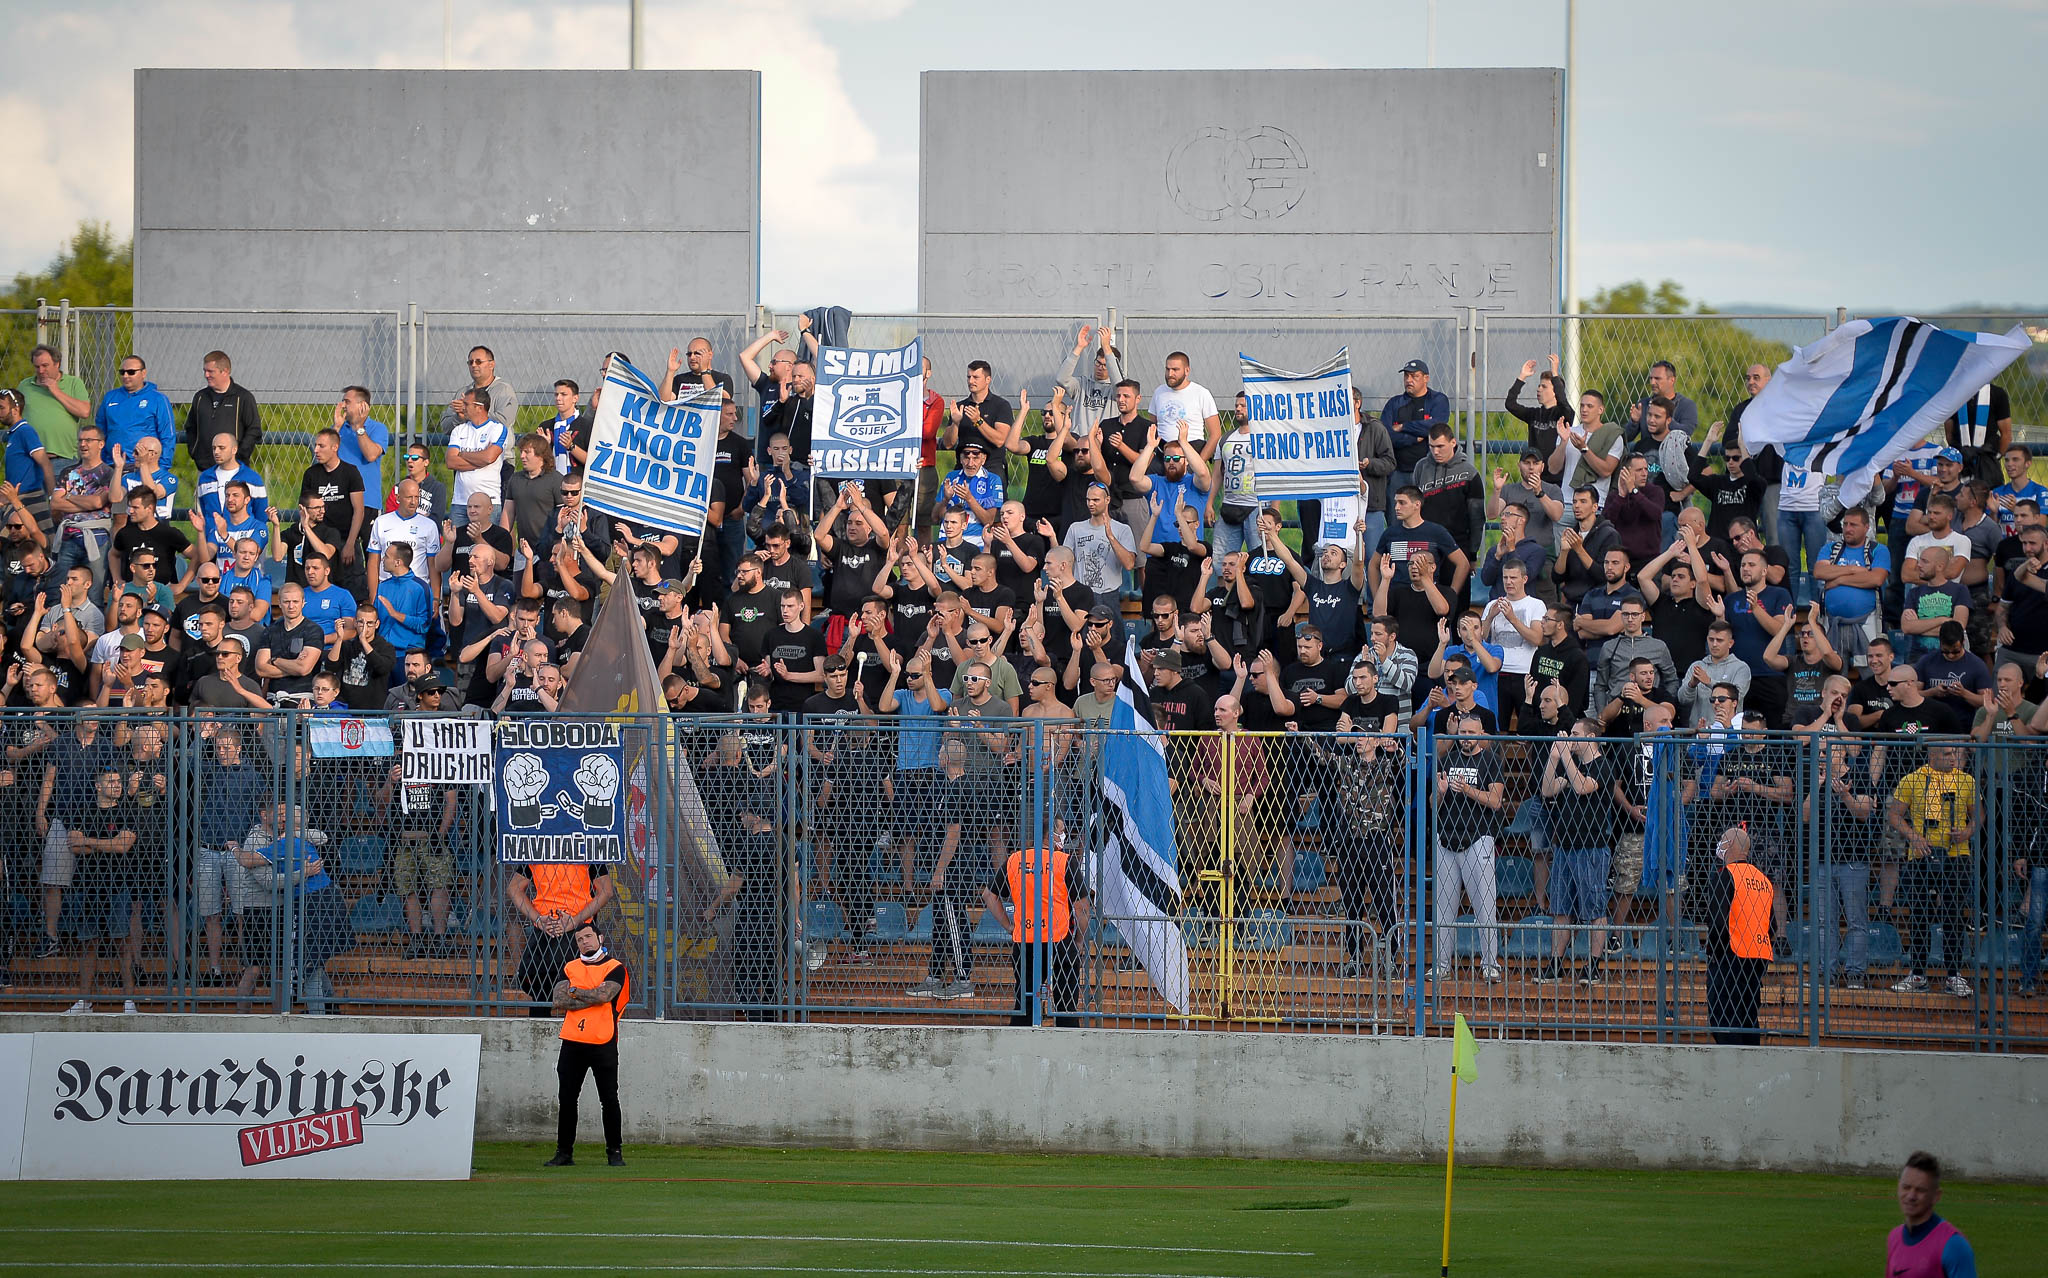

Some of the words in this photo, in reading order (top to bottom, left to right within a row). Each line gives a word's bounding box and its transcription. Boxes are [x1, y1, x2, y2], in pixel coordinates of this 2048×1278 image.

[824, 341, 918, 376] SAMO
[620, 392, 702, 438] KLUB
[1296, 392, 1315, 419] TE
[1318, 384, 1350, 417] NAŠI
[618, 422, 697, 467] MOG
[849, 425, 888, 436] OSIJEK
[1304, 429, 1350, 459] PRATE
[590, 440, 708, 502] ŽIVOTA
[411, 721, 424, 748] U
[432, 722, 479, 749] INAT
[501, 722, 621, 749] SLOBODA
[403, 753, 491, 781] DRUGIMA
[502, 831, 621, 863] NAVIJAČIMA
[577, 1018, 587, 1033] 4
[53, 1055, 452, 1127] Varaždinske
[244, 1110, 358, 1161] VIJESTI
